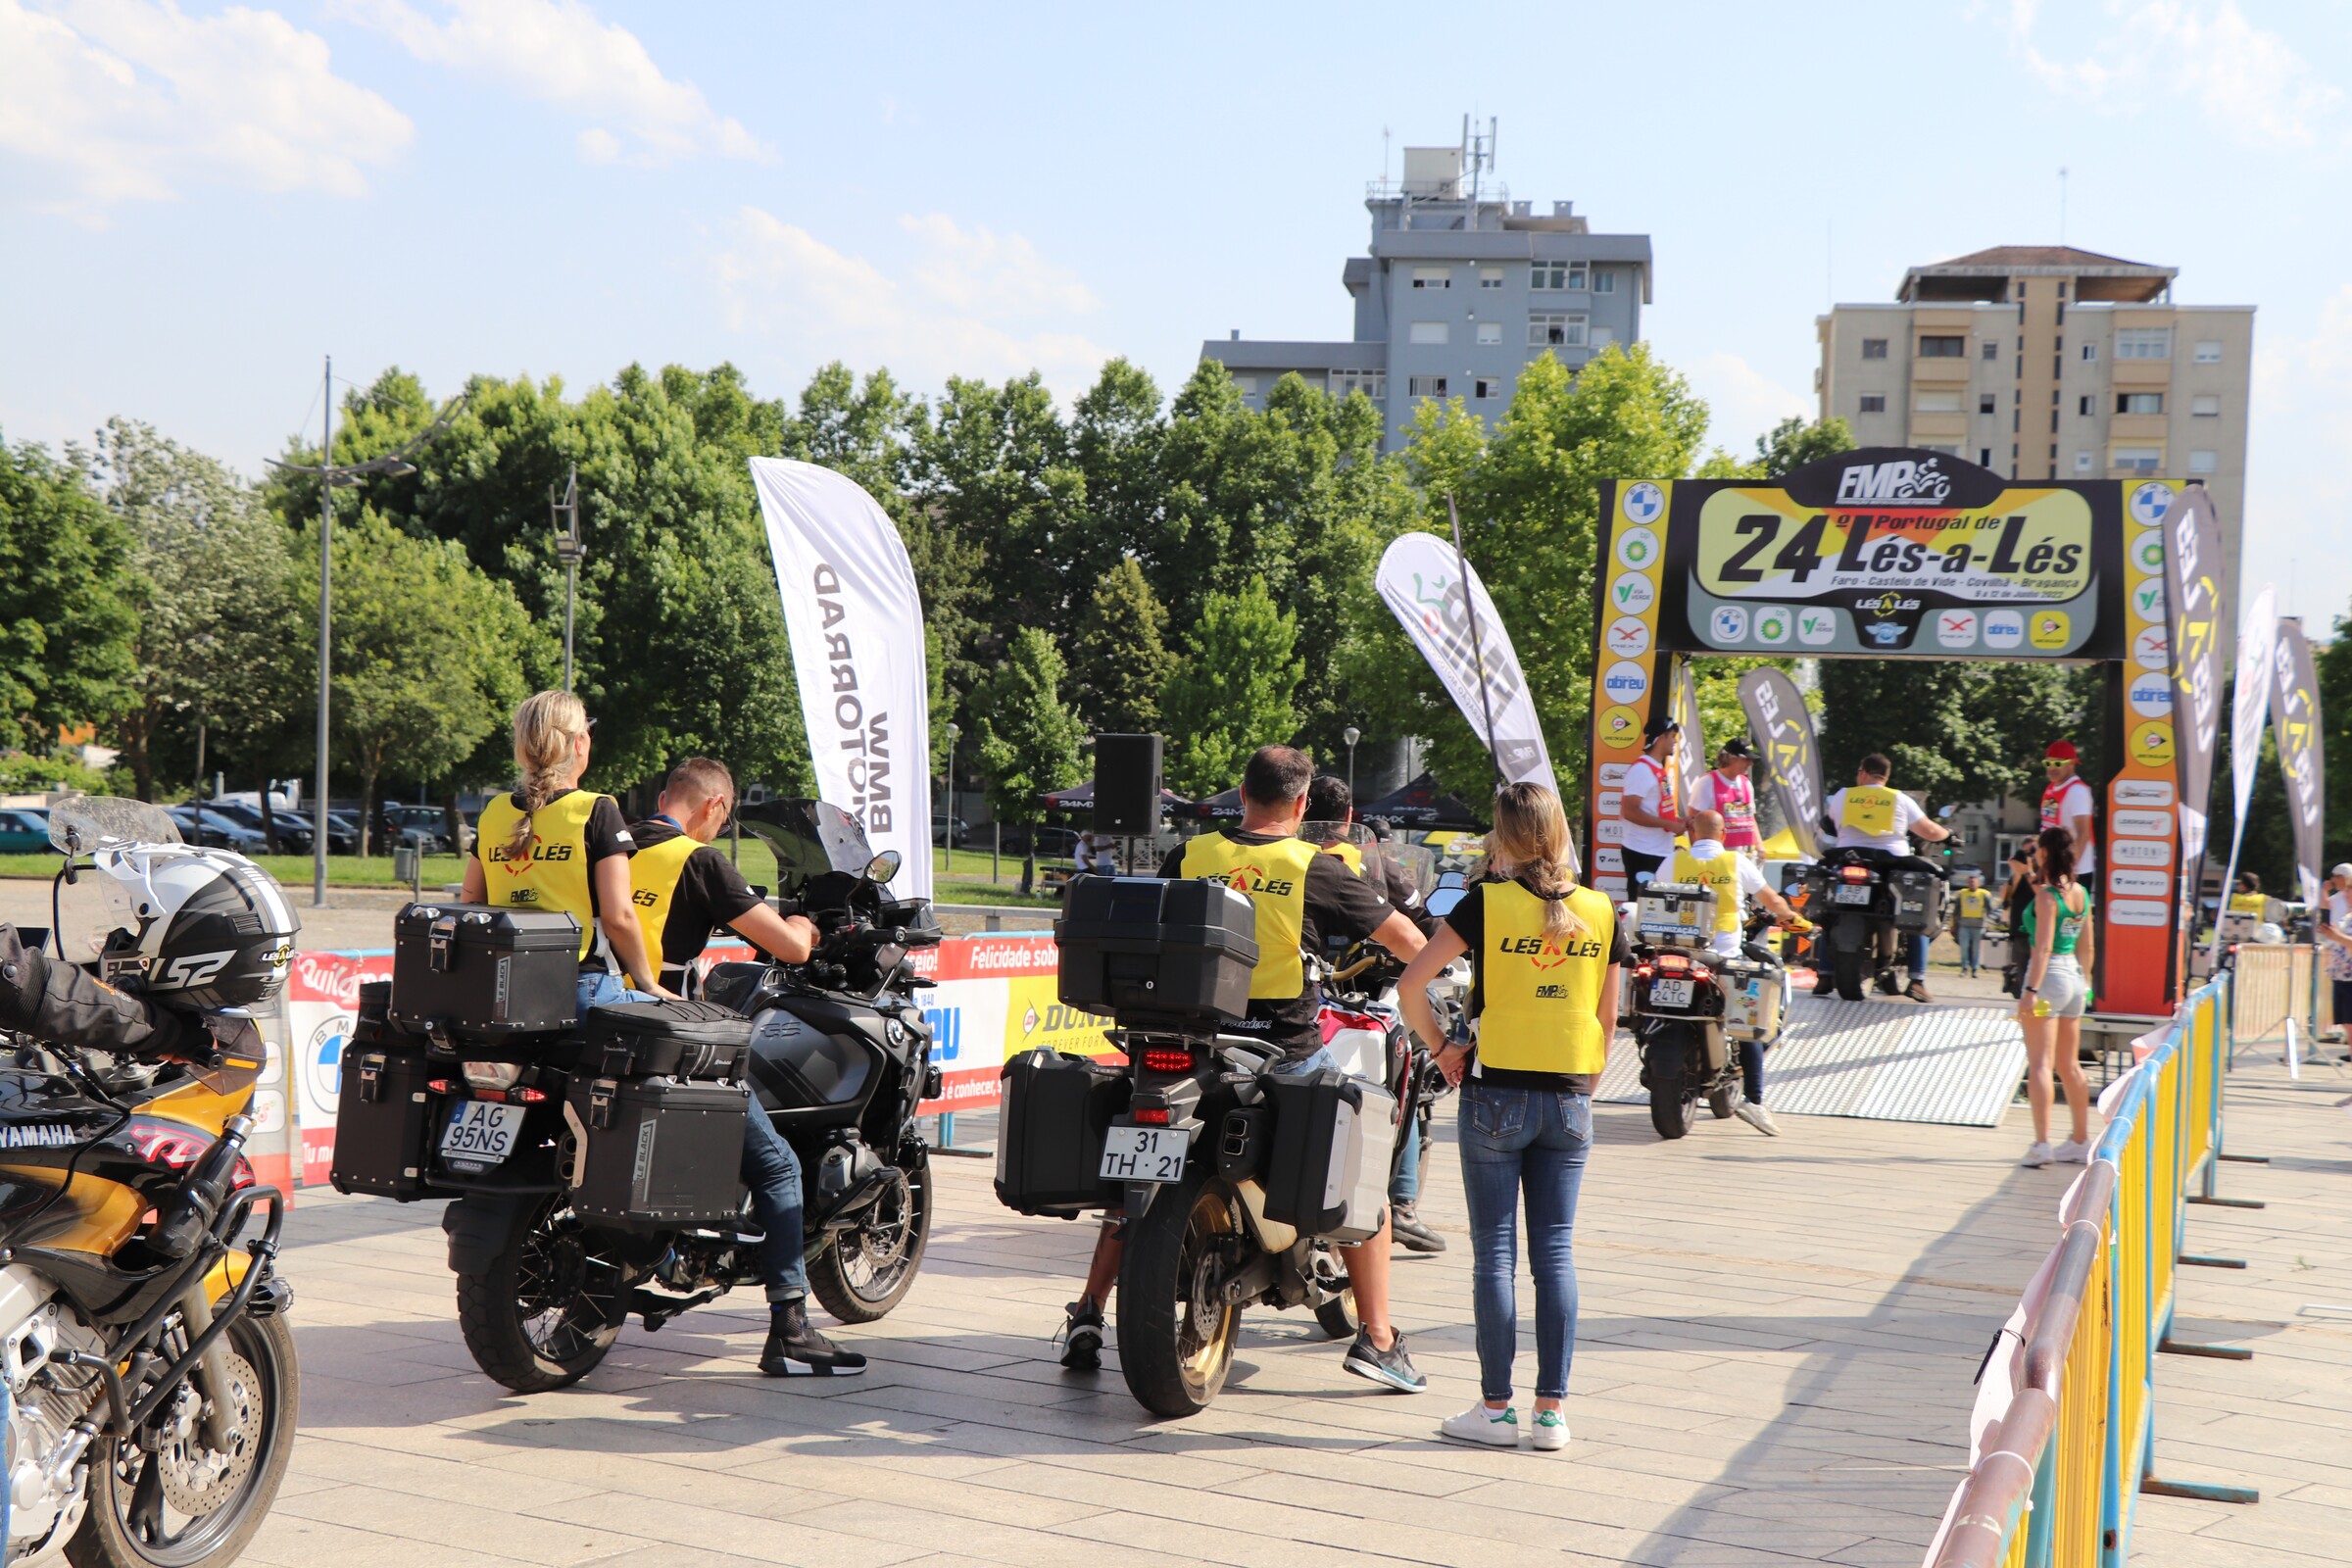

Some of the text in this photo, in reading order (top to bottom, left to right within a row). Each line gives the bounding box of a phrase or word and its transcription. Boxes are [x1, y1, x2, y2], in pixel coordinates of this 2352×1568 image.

[1837, 461, 1917, 498] FMP
[1874, 515, 1971, 530] Portugal
[1975, 515, 2001, 529] de
[1836, 515, 2083, 574] Lés-a-Lés
[1831, 576, 1859, 586] Faro
[1868, 576, 1911, 586] Castelo
[1914, 577, 1929, 586] de
[1932, 577, 1957, 587] Vide
[2020, 578, 2080, 589] Bragança
[1606, 675, 1644, 690] abreu
[2132, 688, 2173, 703] abre
[1362, 813, 1405, 824] 24MX
[533, 843, 572, 861] LÉS
[1251, 878, 1294, 897] LÉS
[632, 888, 659, 907] ÉS
[1642, 924, 1700, 935] ORGANIZAÇÃO
[1499, 936, 1544, 956] LÉS
[1567, 939, 1602, 958] LÉS
[969, 945, 1031, 970] Felicidade
[1535, 985, 1558, 998] FMP
[1662, 980, 1682, 992] AD
[1654, 990, 1687, 1003] 24TC
[760, 1021, 802, 1038] GS
[947, 1080, 954, 1100] é
[955, 1078, 997, 1099] conhecer,
[469, 1104, 505, 1128] AG
[0, 1124, 76, 1148] YAMAHA
[450, 1126, 509, 1152] 95NS
[1134, 1131, 1158, 1153] 31
[303, 1145, 315, 1163] Tu
[639, 1129, 650, 1162] BLACK
